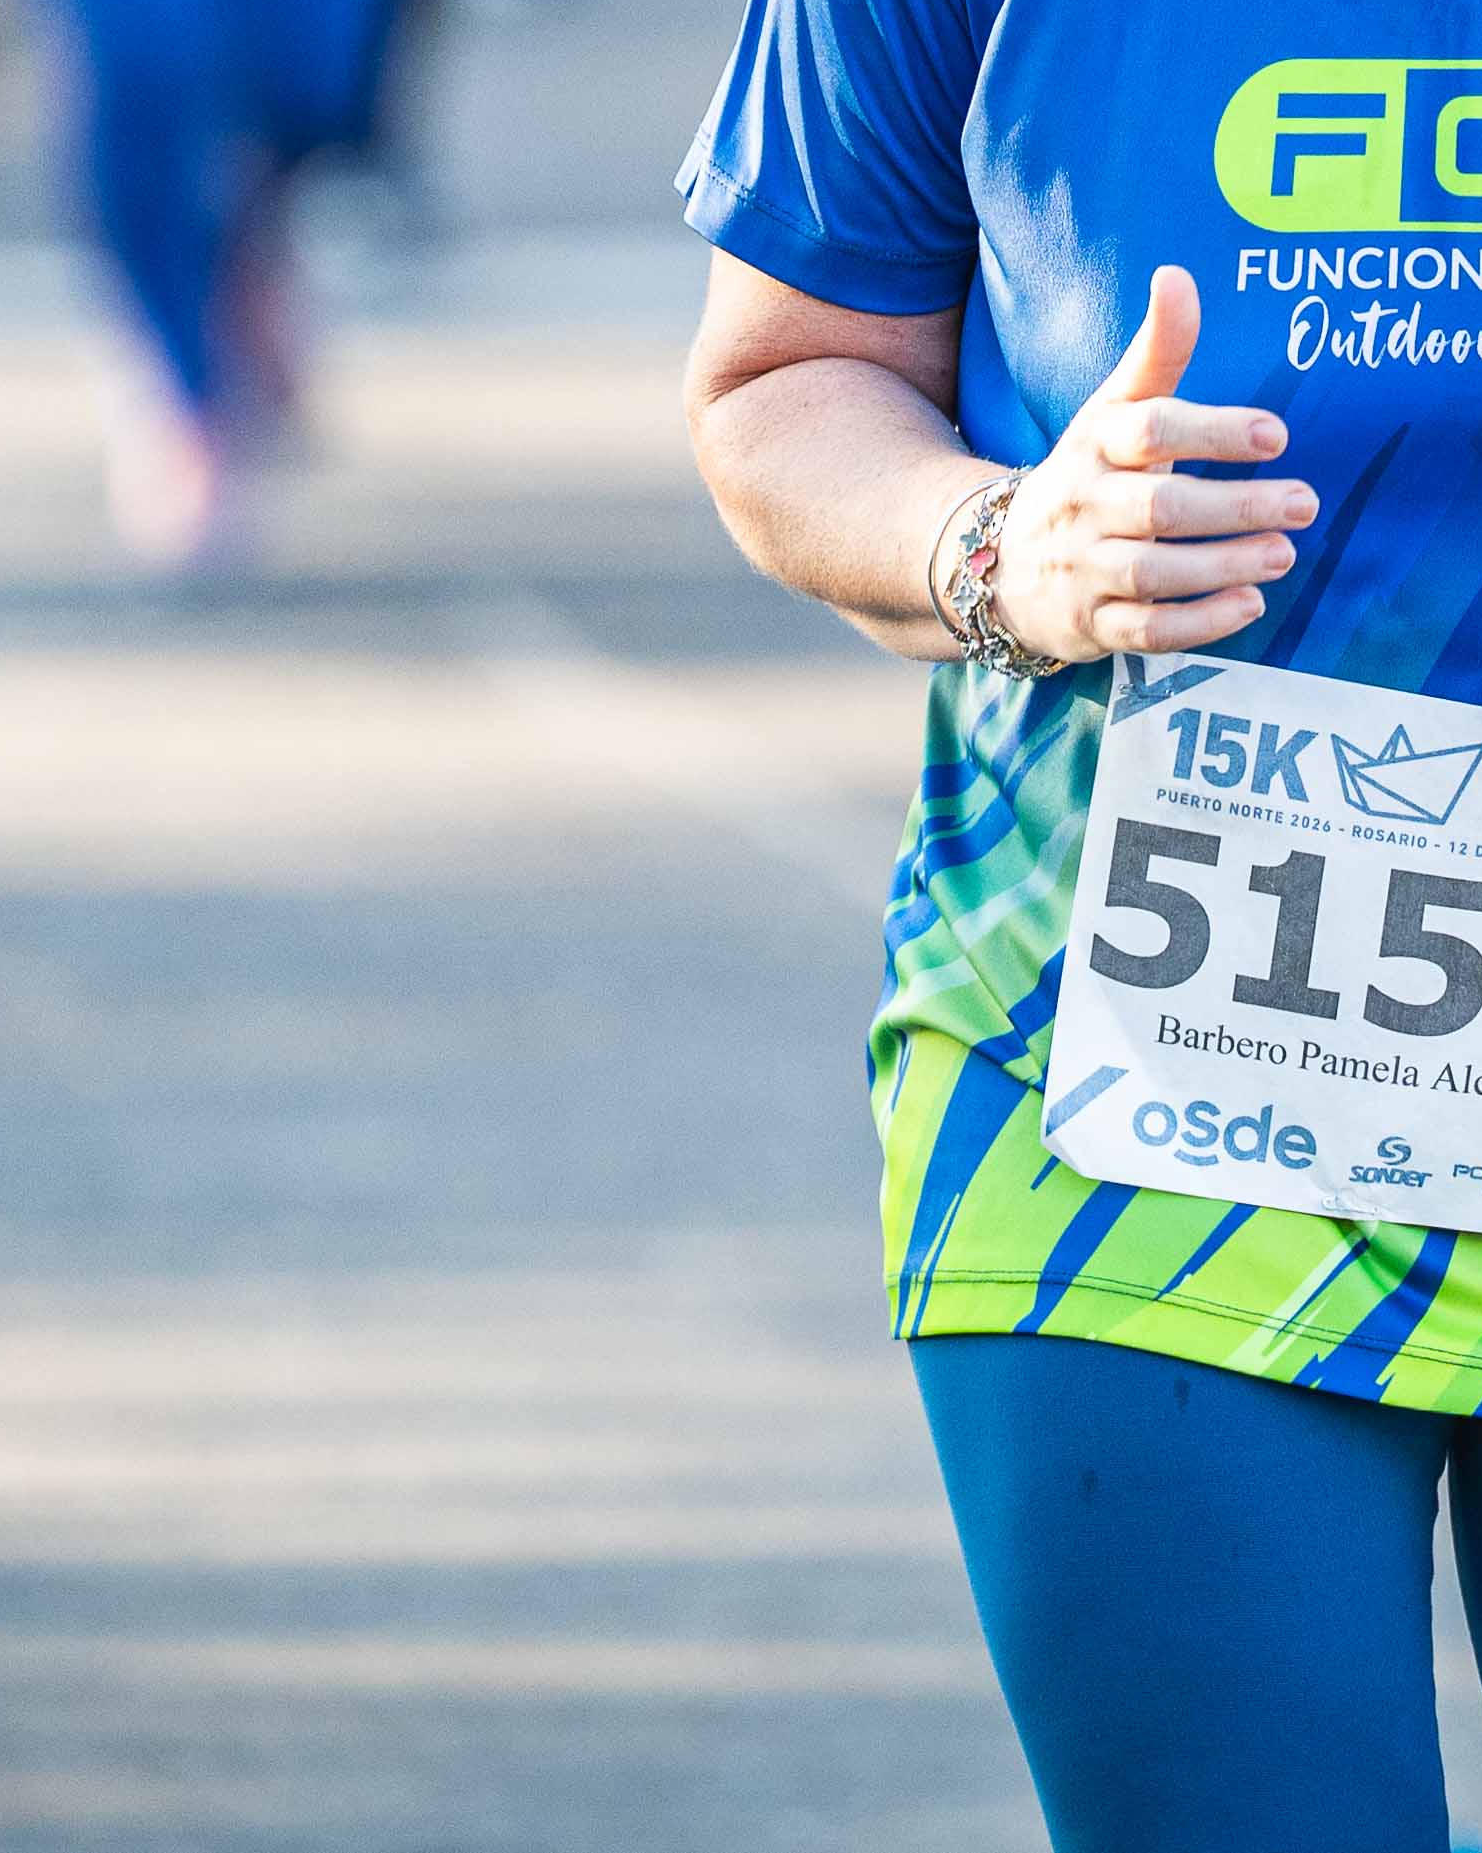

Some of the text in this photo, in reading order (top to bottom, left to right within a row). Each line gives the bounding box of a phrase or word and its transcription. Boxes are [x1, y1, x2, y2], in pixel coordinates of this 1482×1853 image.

[1167, 707, 1319, 803] 15K
[1156, 788, 1223, 812] PUERTO
[1229, 802, 1284, 824] NORTE
[1290, 814, 1332, 833] 2026
[1351, 824, 1428, 849] ROSARIO
[1449, 841, 1468, 856] 12
[1154, 1013, 1287, 1066] Barbero
[1298, 1040, 1420, 1088] Pamela
[1132, 1100, 1318, 1170] osde
